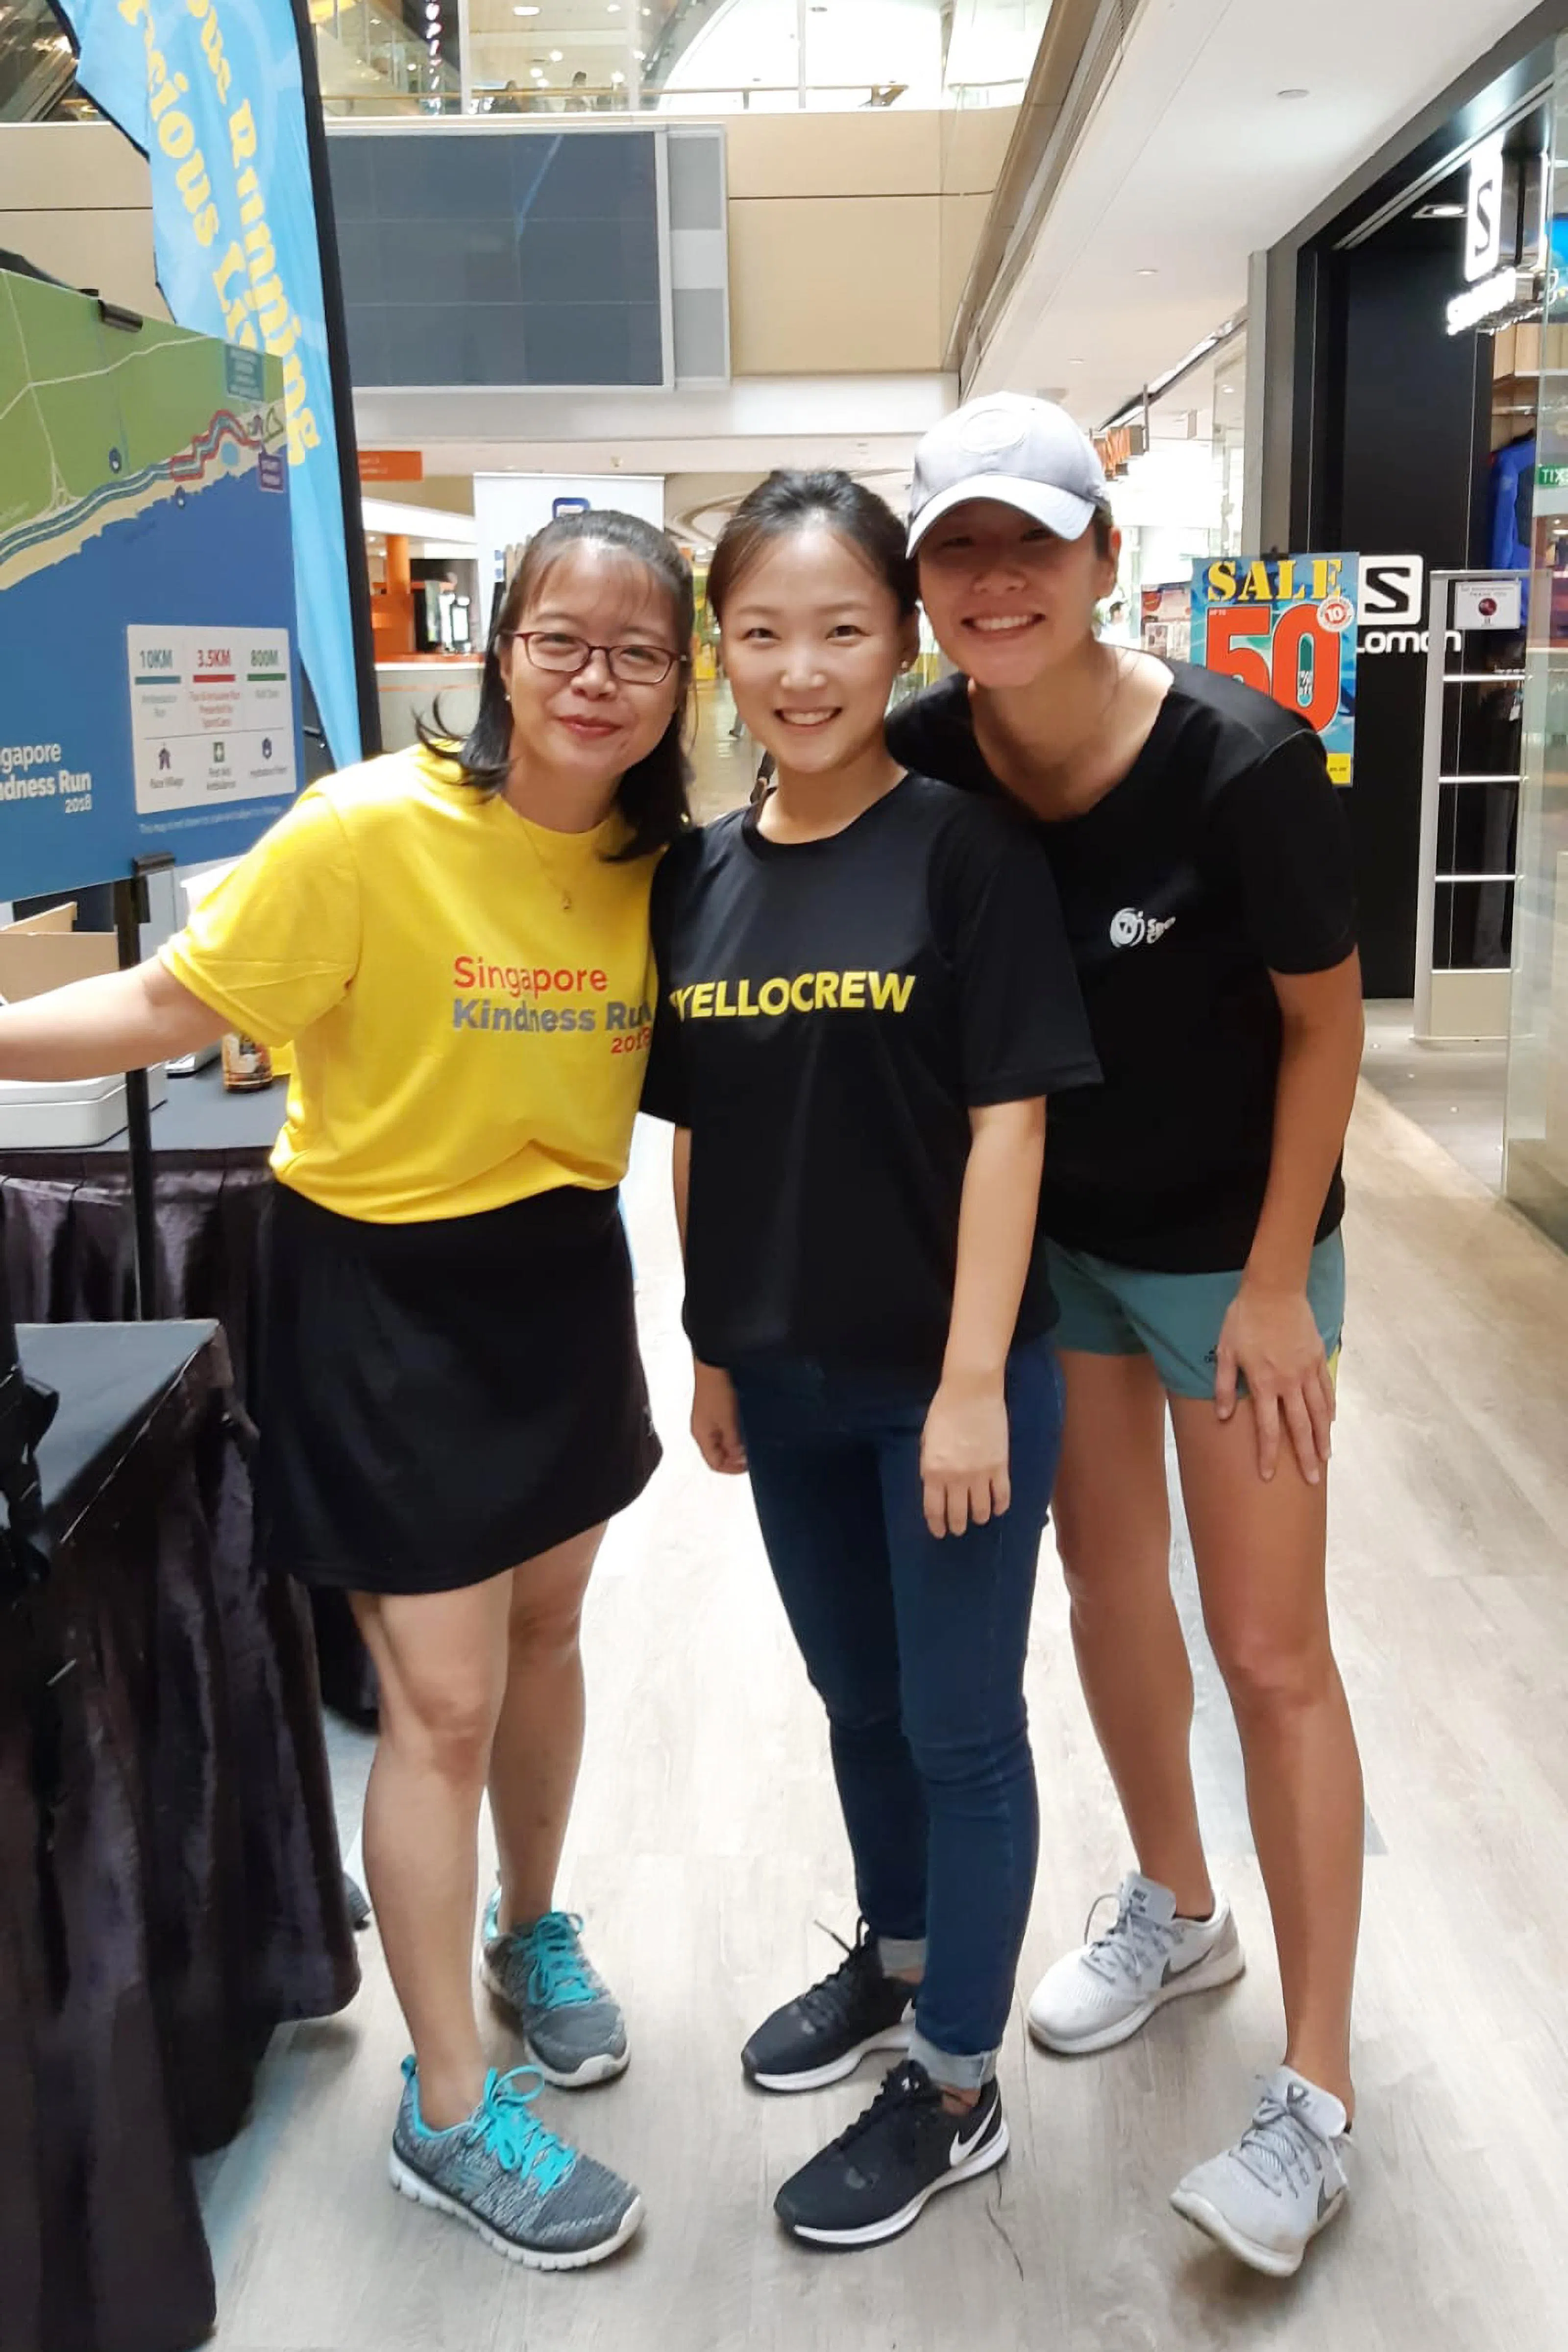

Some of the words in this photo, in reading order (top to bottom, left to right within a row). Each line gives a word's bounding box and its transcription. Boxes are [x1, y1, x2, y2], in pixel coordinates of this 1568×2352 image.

[1207, 559, 1343, 602] SALE
[1364, 566, 1411, 613] S
[139, 648, 173, 669] 10KM
[197, 648, 231, 667] 3.5KM
[250, 649, 279, 667] 800M
[58, 769, 93, 794] Run
[454, 956, 608, 1000] Singapore
[668, 971, 916, 1022] YELLOCREW
[453, 998, 597, 1032] Kindness
